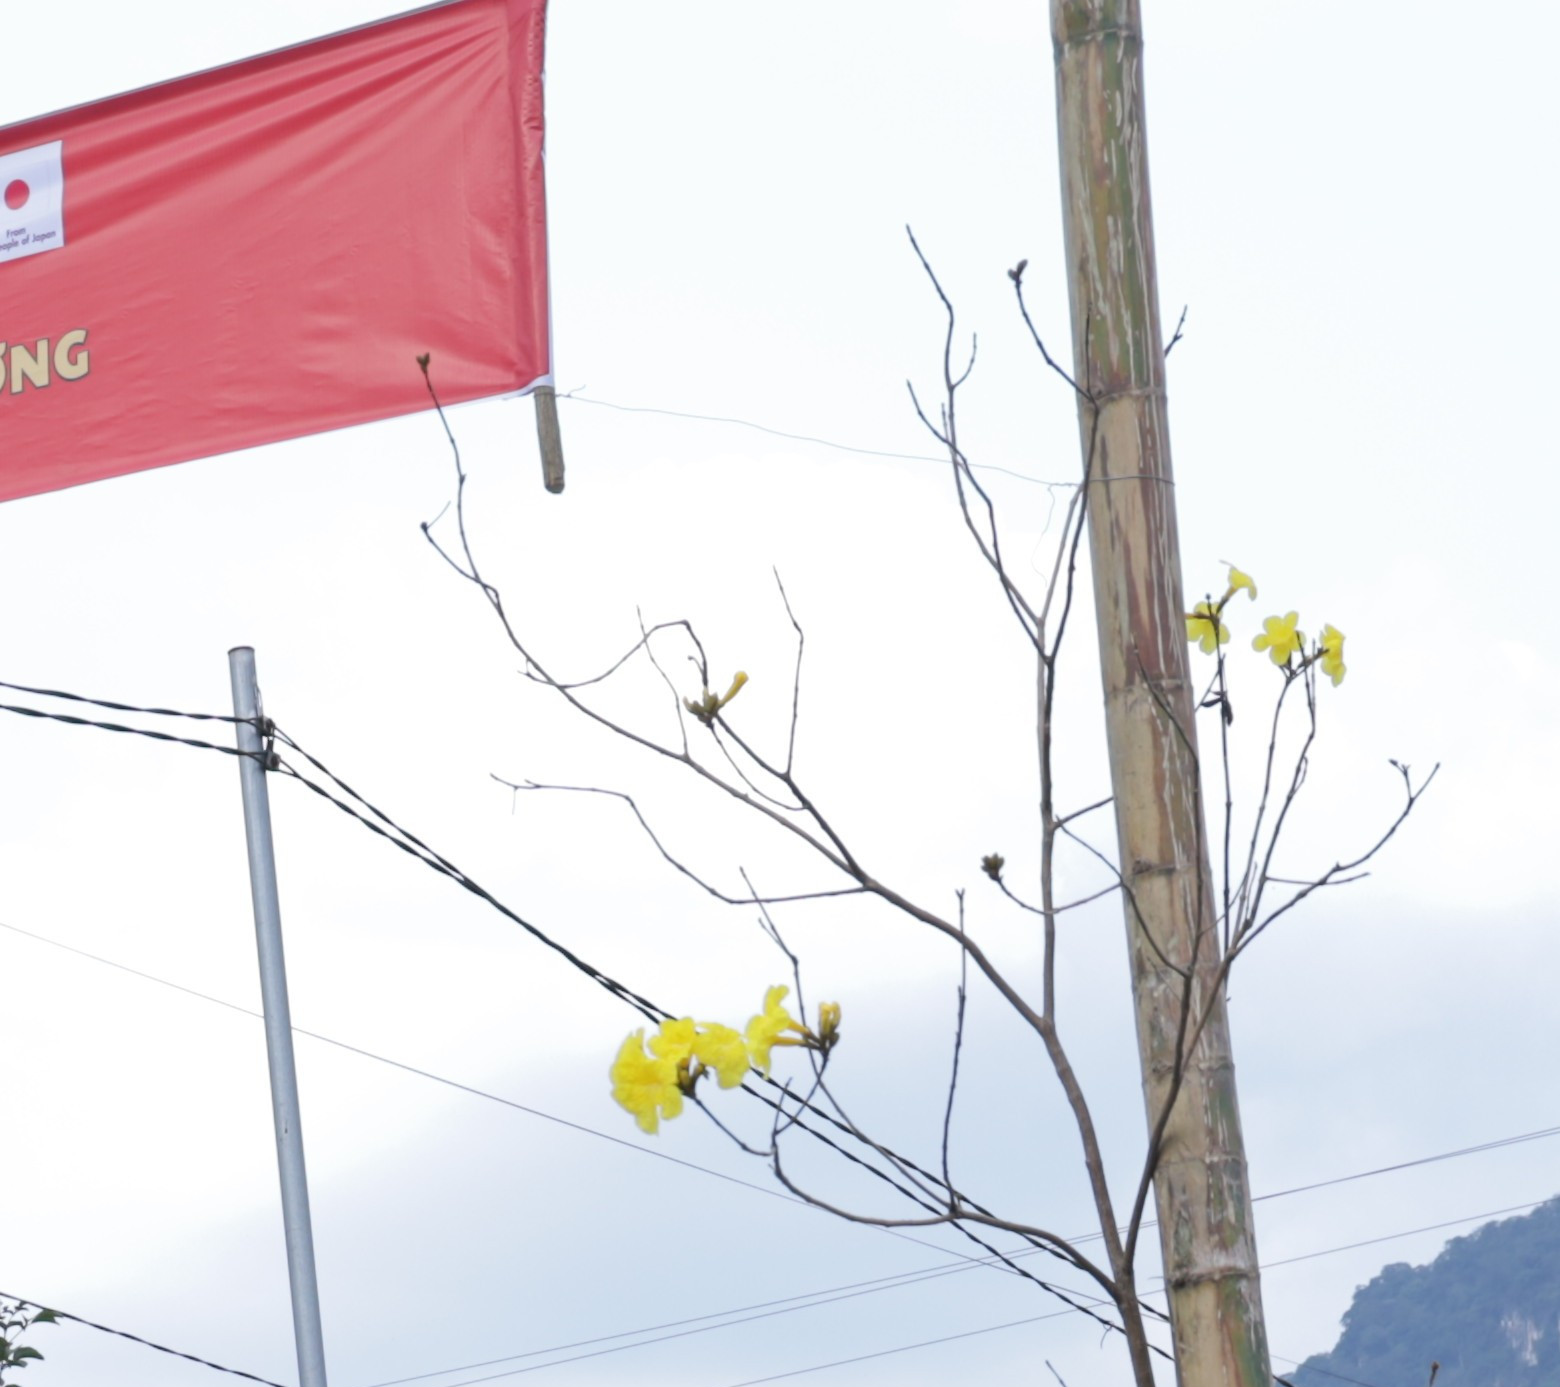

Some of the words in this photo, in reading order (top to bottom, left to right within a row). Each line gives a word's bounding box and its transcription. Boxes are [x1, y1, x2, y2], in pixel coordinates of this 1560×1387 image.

[6, 227, 26, 239] From
[21, 233, 30, 246] of
[32, 230, 57, 244] Japan
